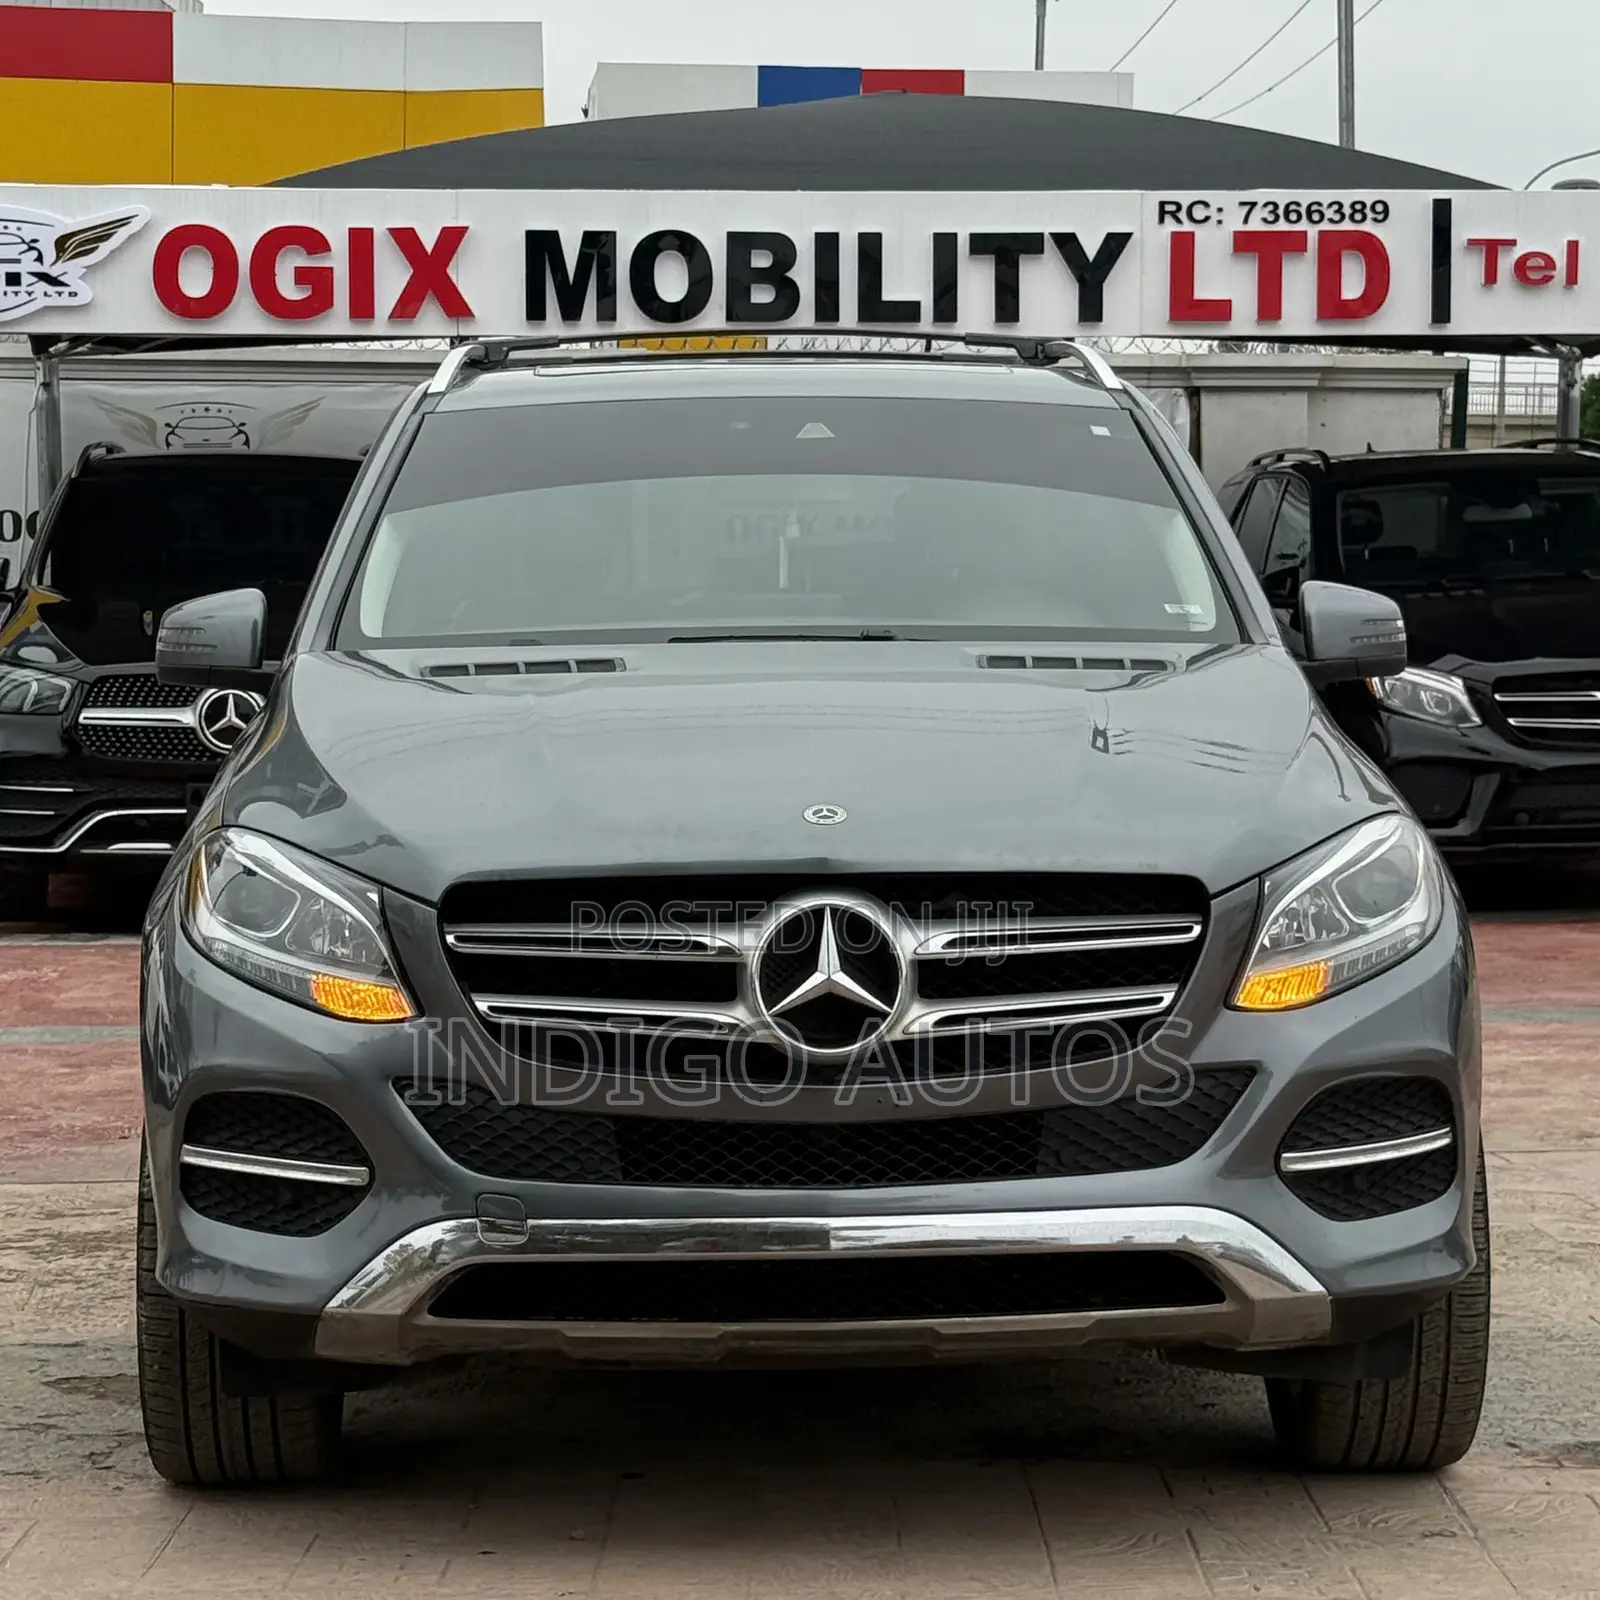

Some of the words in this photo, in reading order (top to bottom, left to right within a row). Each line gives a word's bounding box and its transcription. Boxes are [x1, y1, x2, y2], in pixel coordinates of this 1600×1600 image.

[1157, 199, 1224, 226] RC:
[1237, 199, 1391, 225] 7366389
[152, 223, 476, 321] OGIX
[524, 228, 1135, 325] MOBILITY
[1168, 229, 1391, 322] LTD
[1465, 238, 1580, 287] Tel
[43, 290, 79, 298] LTD
